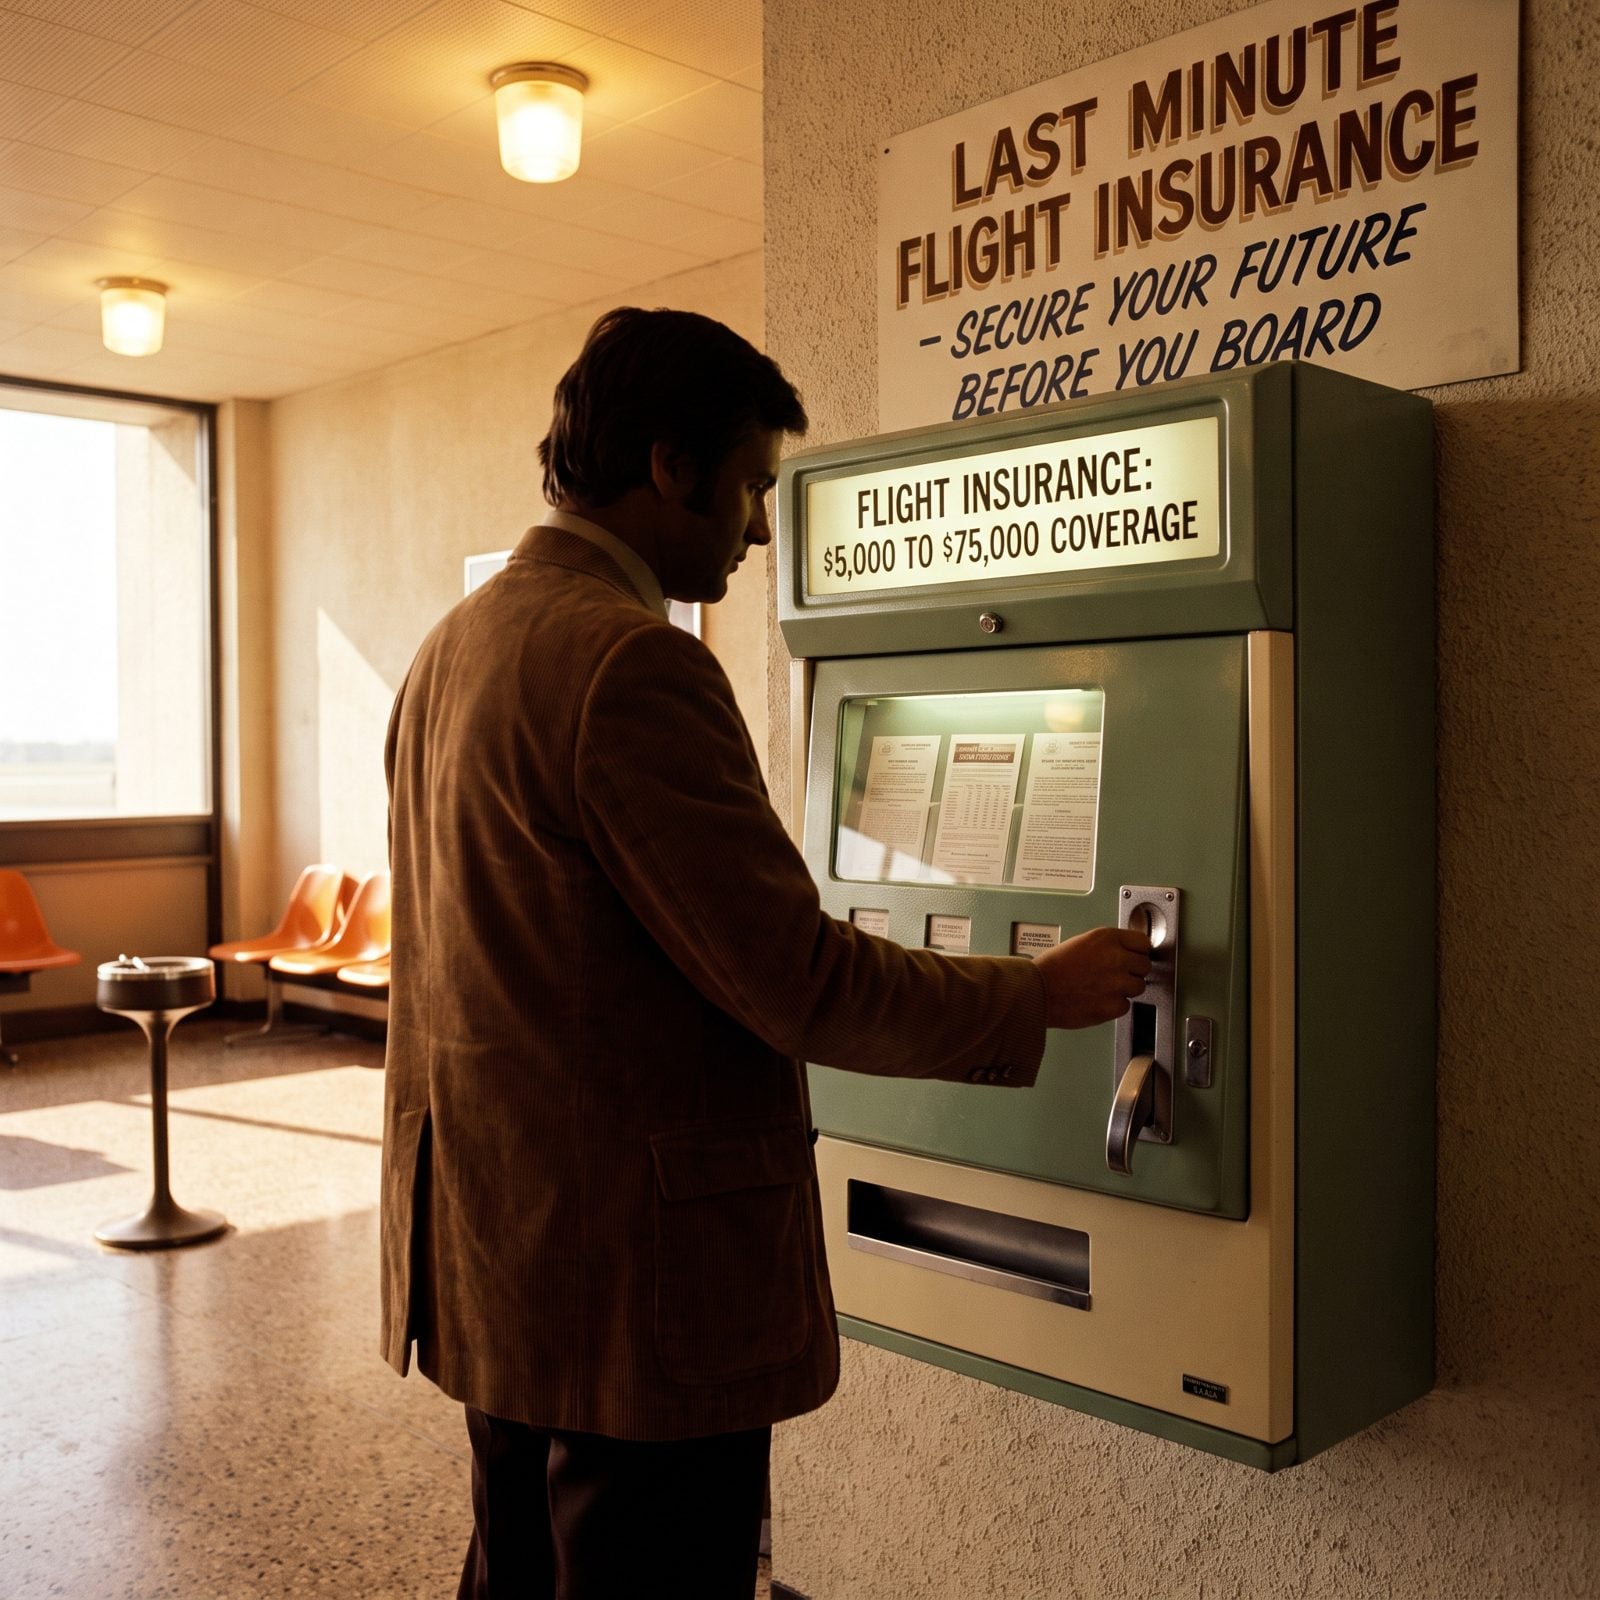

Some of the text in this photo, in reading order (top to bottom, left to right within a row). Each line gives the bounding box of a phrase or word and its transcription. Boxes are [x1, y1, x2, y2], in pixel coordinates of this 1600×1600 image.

[951, 0, 1402, 211] LAST MINUTE
[896, 72, 1480, 311] FLIGHT INSURANCE
[950, 282, 1095, 359] SECURE
[1107, 254, 1217, 326] YOUR
[1230, 202, 1427, 299] FUTURE
[952, 292, 1382, 421] BEFORE YOU BOARD
[823, 499, 1199, 581] $5,000 TO $75,000 COVERAGE
[857, 447, 1153, 529] FLIGHT INSURANCE:
